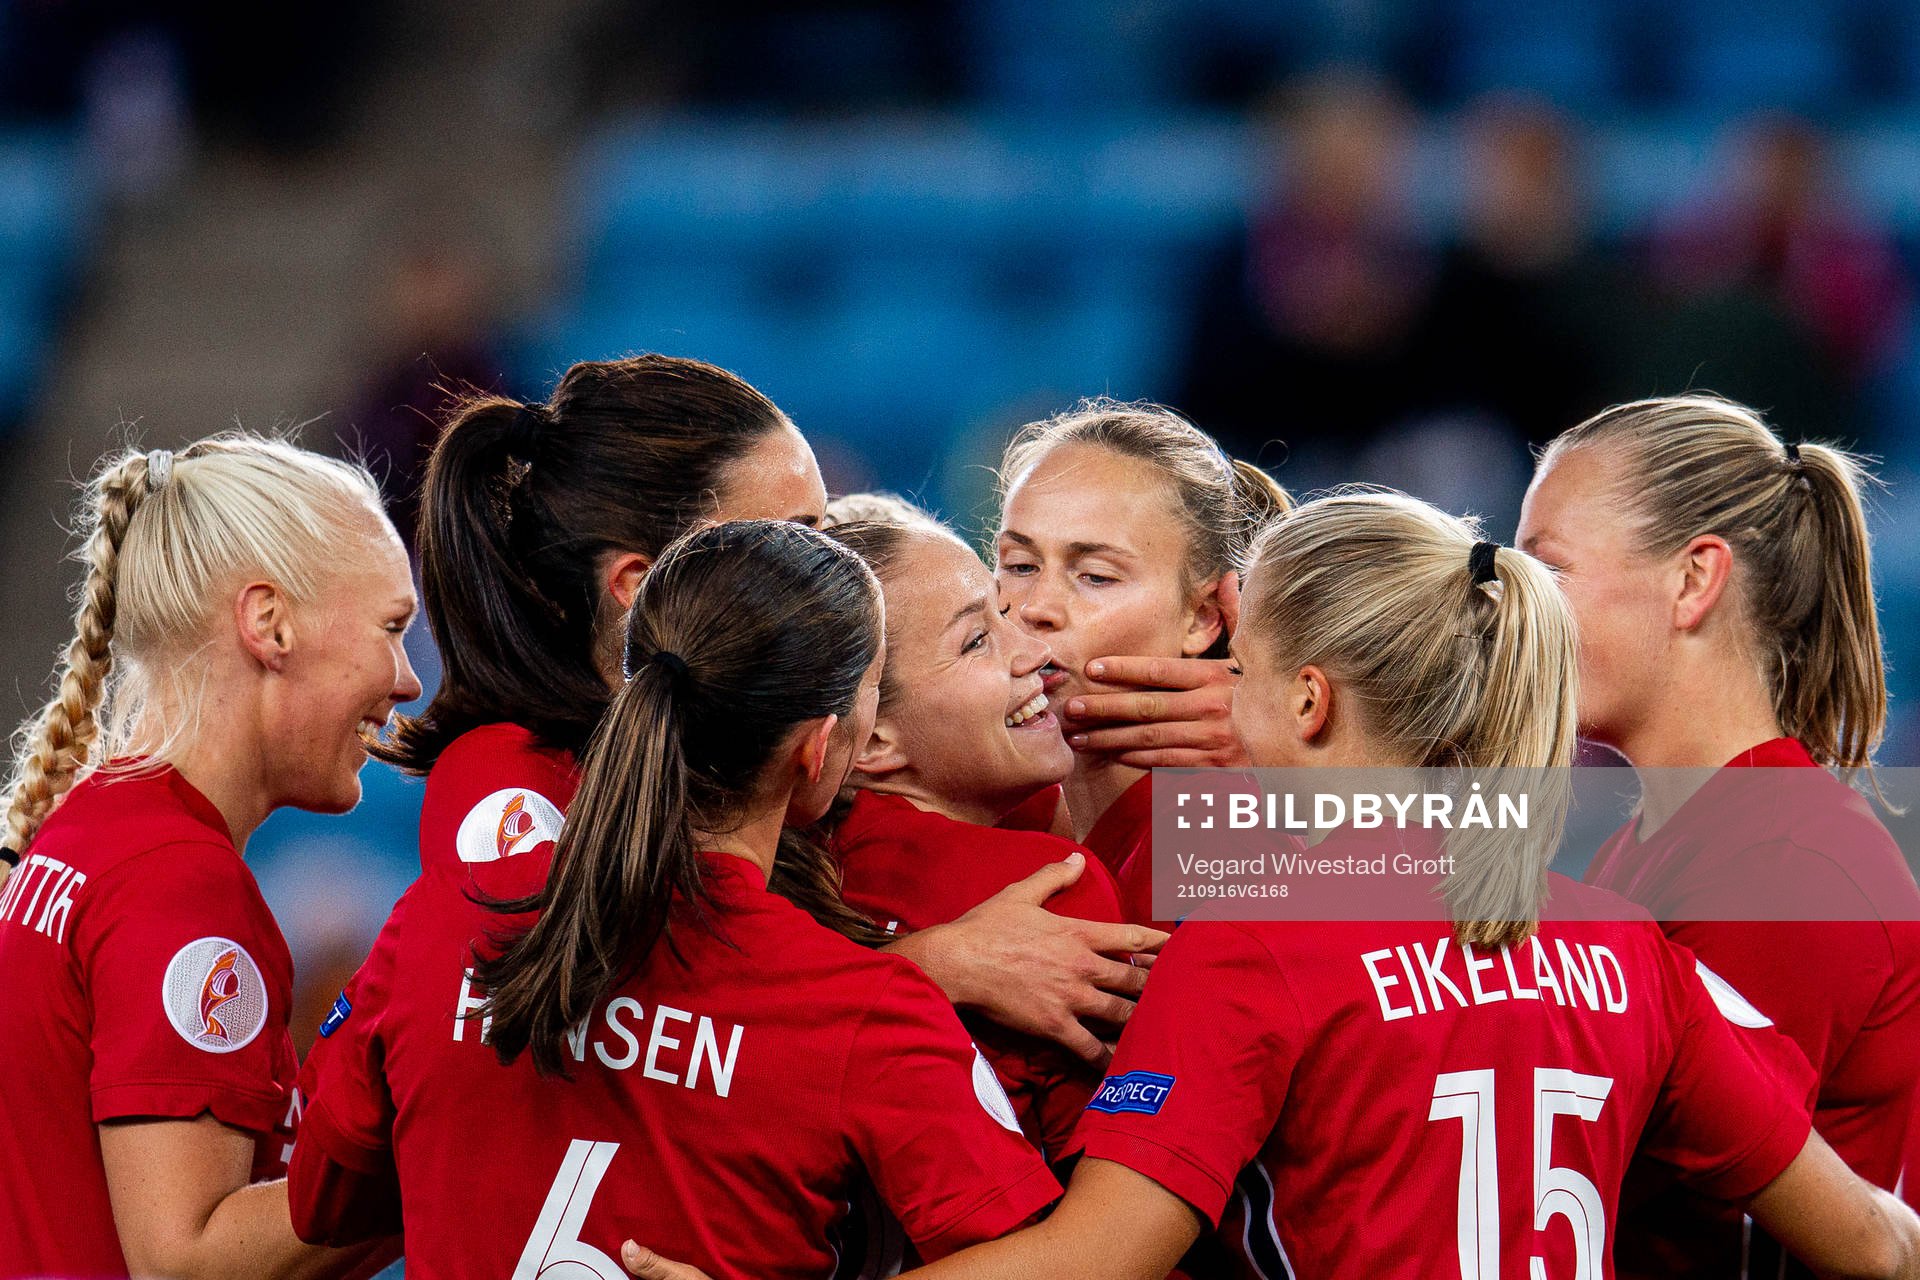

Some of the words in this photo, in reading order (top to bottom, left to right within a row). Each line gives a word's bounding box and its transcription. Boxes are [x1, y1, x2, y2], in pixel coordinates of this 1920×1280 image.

[453, 967, 745, 1098] HNSEN
[1360, 935, 1629, 1022] EIKELAND
[1428, 1066, 1614, 1280] 15
